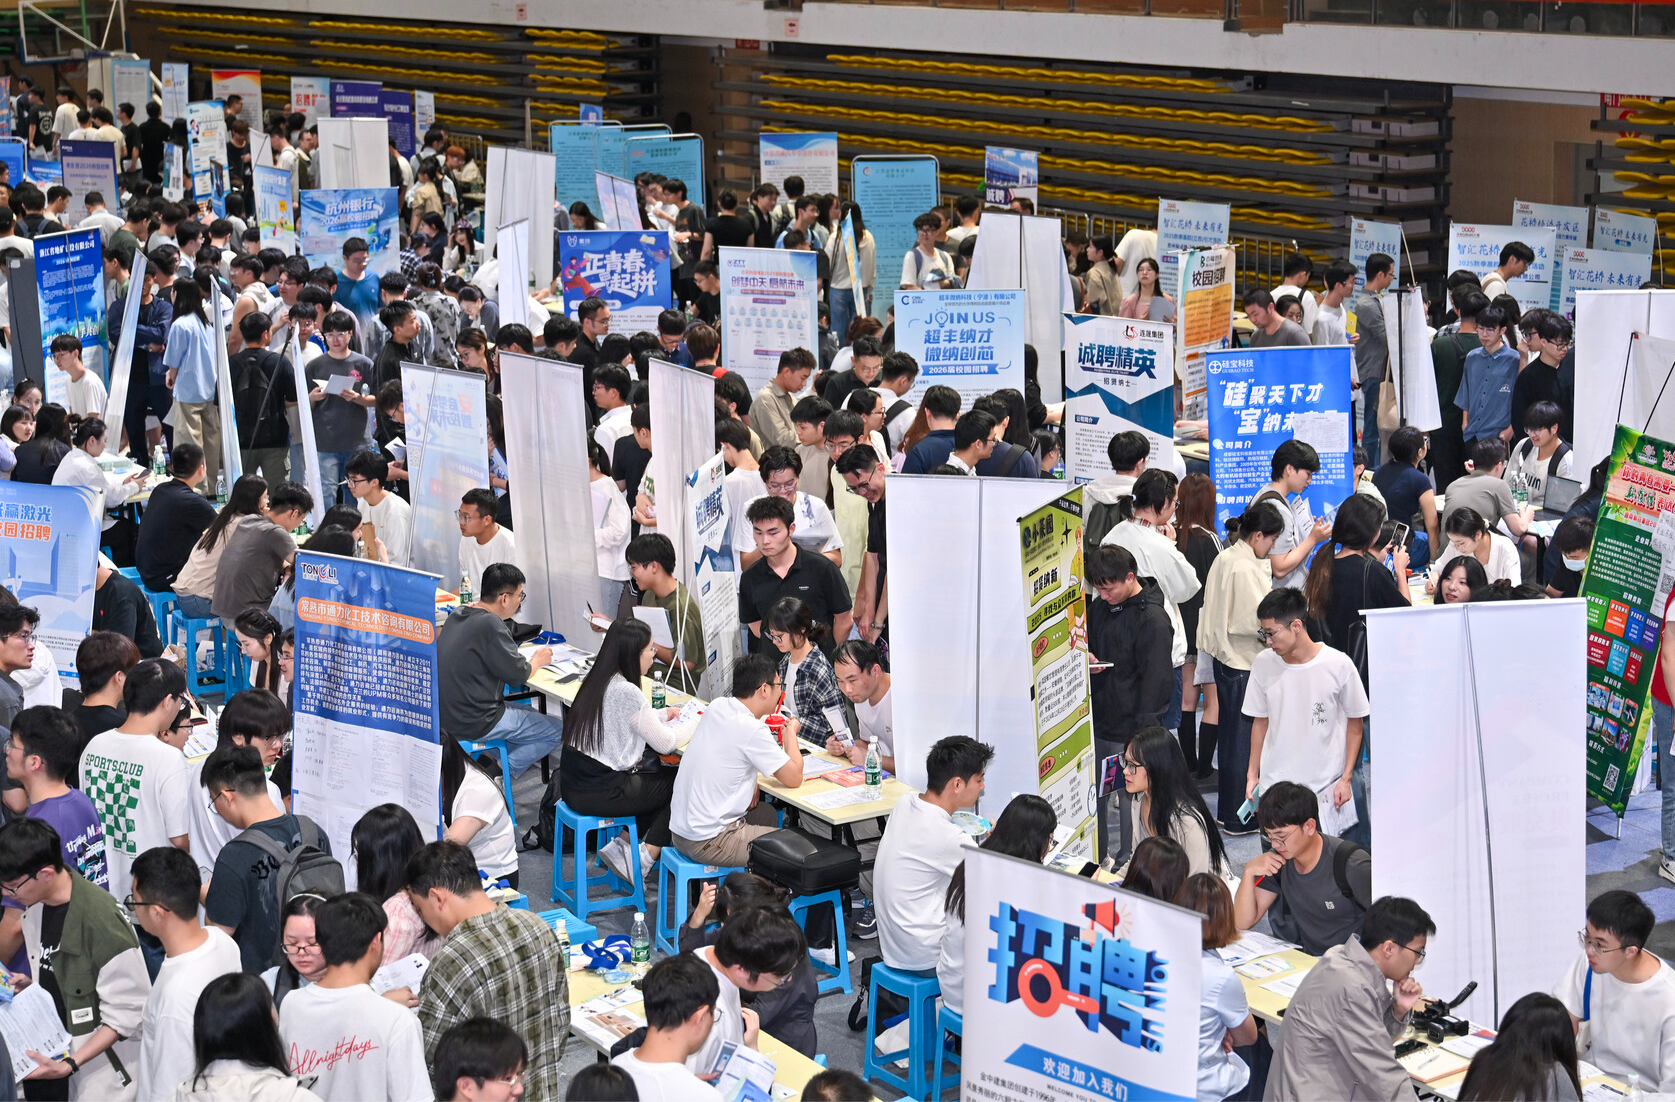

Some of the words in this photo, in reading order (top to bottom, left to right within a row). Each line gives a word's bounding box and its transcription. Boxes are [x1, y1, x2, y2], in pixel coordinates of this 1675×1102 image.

[325, 196, 375, 215] 杭州银行
[580, 248, 647, 278] 正青春
[1191, 266, 1226, 287] 校园招聘
[924, 311, 969, 328] JOIN
[973, 311, 996, 324] US
[924, 328, 994, 344] 超丰纳才
[925, 346, 994, 362] 微纳创芯
[1078, 342, 1157, 380] 诚聘精英
[928, 365, 989, 374] 2026届校园招聘
[1222, 359, 1254, 369] 硅宝科技
[1103, 377, 1132, 388] 招贤纳士
[1032, 513, 1054, 544] 小菜园
[301, 600, 430, 636] 常熟市通力化工技术咨询有限公司
[118, 761, 144, 777] CLUB
[988, 900, 1148, 1050] 招聘
[1042, 1057, 1128, 1102] 欢迎加入我们
[1046, 1083, 1074, 1098] WELCOME
